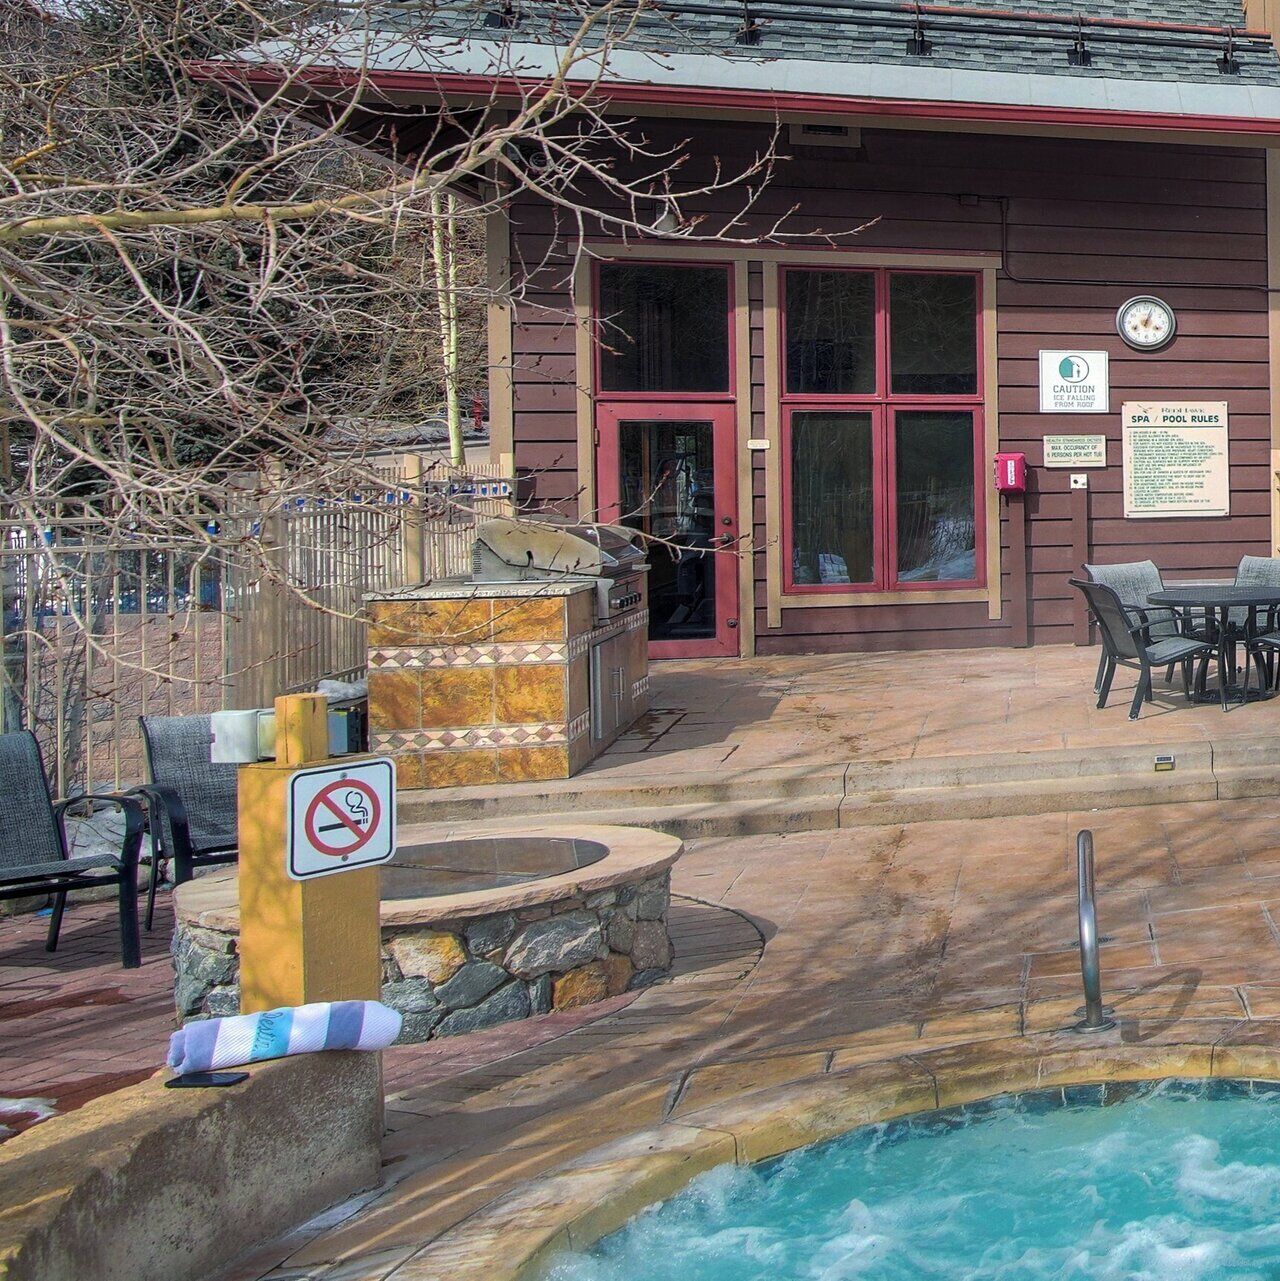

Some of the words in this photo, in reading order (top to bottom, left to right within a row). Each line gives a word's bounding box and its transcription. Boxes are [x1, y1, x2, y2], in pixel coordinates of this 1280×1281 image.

[1053, 385, 1095, 394] CAUTION
[1131, 415, 1150, 423] SPA
[1162, 415, 1188, 423] POOL
[1191, 415, 1219, 423] RULES
